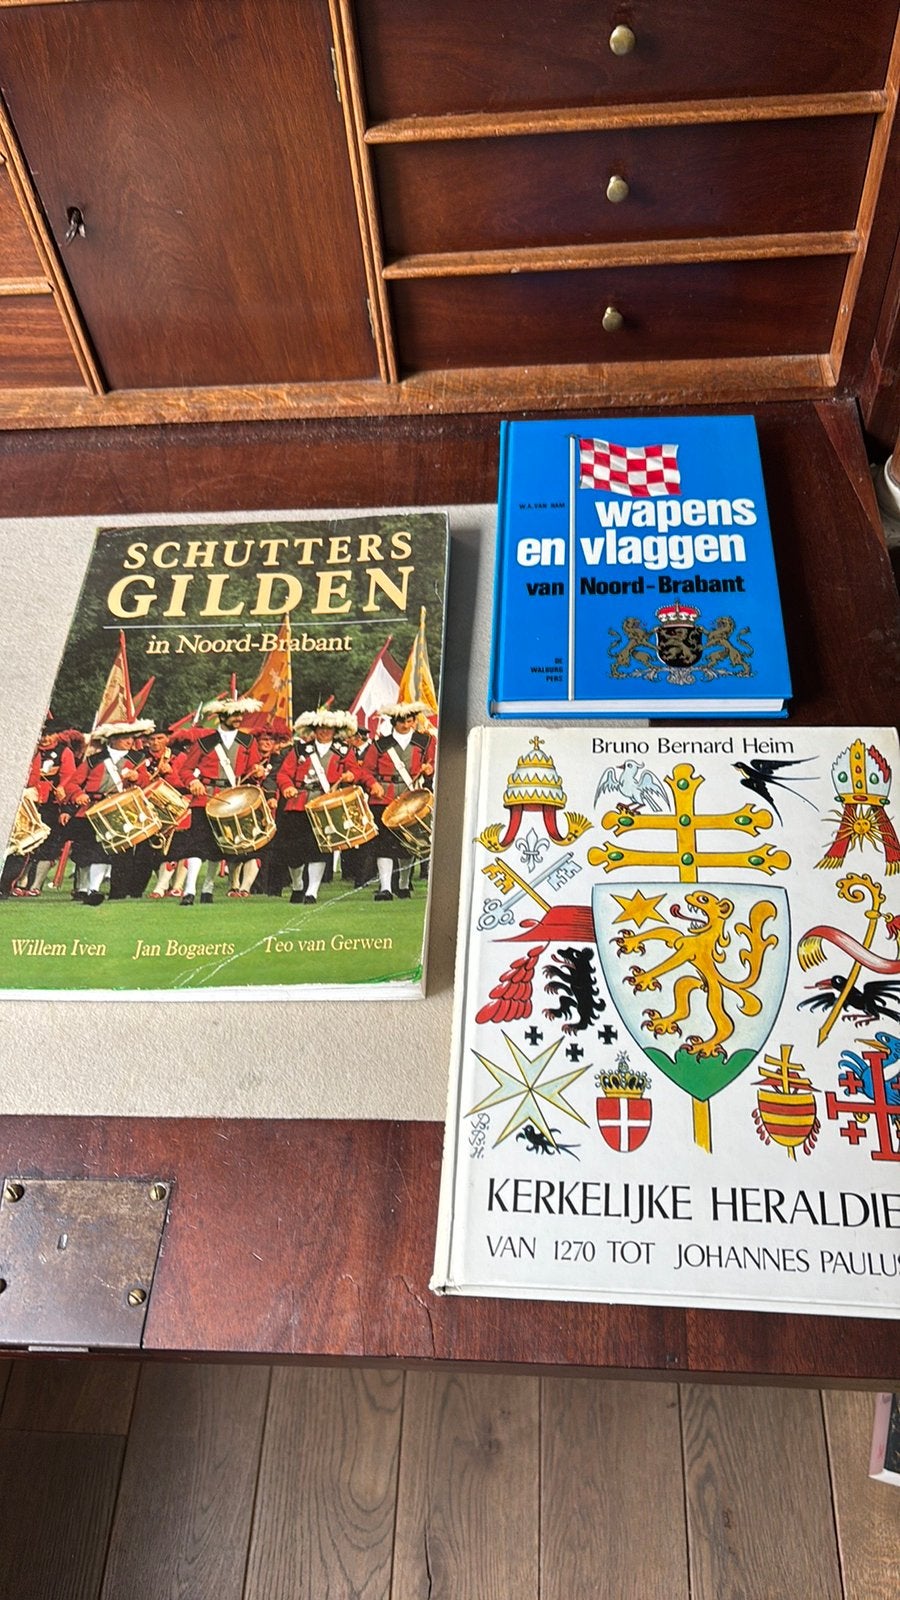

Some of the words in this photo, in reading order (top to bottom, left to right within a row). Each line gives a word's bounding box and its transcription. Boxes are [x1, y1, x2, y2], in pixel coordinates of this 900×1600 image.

[594, 498, 757, 533] wapens
[123, 531, 412, 570] SCHUTTERS
[516, 537, 566, 567] en
[579, 529, 747, 570] vlaggen
[106, 566, 415, 620] GILDEN
[526, 580, 565, 596] van
[146, 634, 170, 655] in
[178, 633, 353, 655] Noord-Brabant
[592, 737, 650, 755] Bruno
[658, 737, 734, 754] Bernard
[742, 737, 795, 754] Heim
[11, 938, 67, 957] Willem
[71, 938, 107, 957] Iven
[132, 939, 161, 961] Jan
[165, 939, 235, 960] Bogaerts
[263, 936, 294, 954] Teo
[297, 940, 326, 953] van
[330, 934, 393, 952] Gerwen
[487, 1177, 693, 1225] KERKELIJKE
[487, 1234, 537, 1260] VAN
[553, 1239, 596, 1263] 1270
[607, 1240, 656, 1265] TOT
[674, 1243, 811, 1274] JOHANNES
[819, 1249, 900, 1278] PAULU
